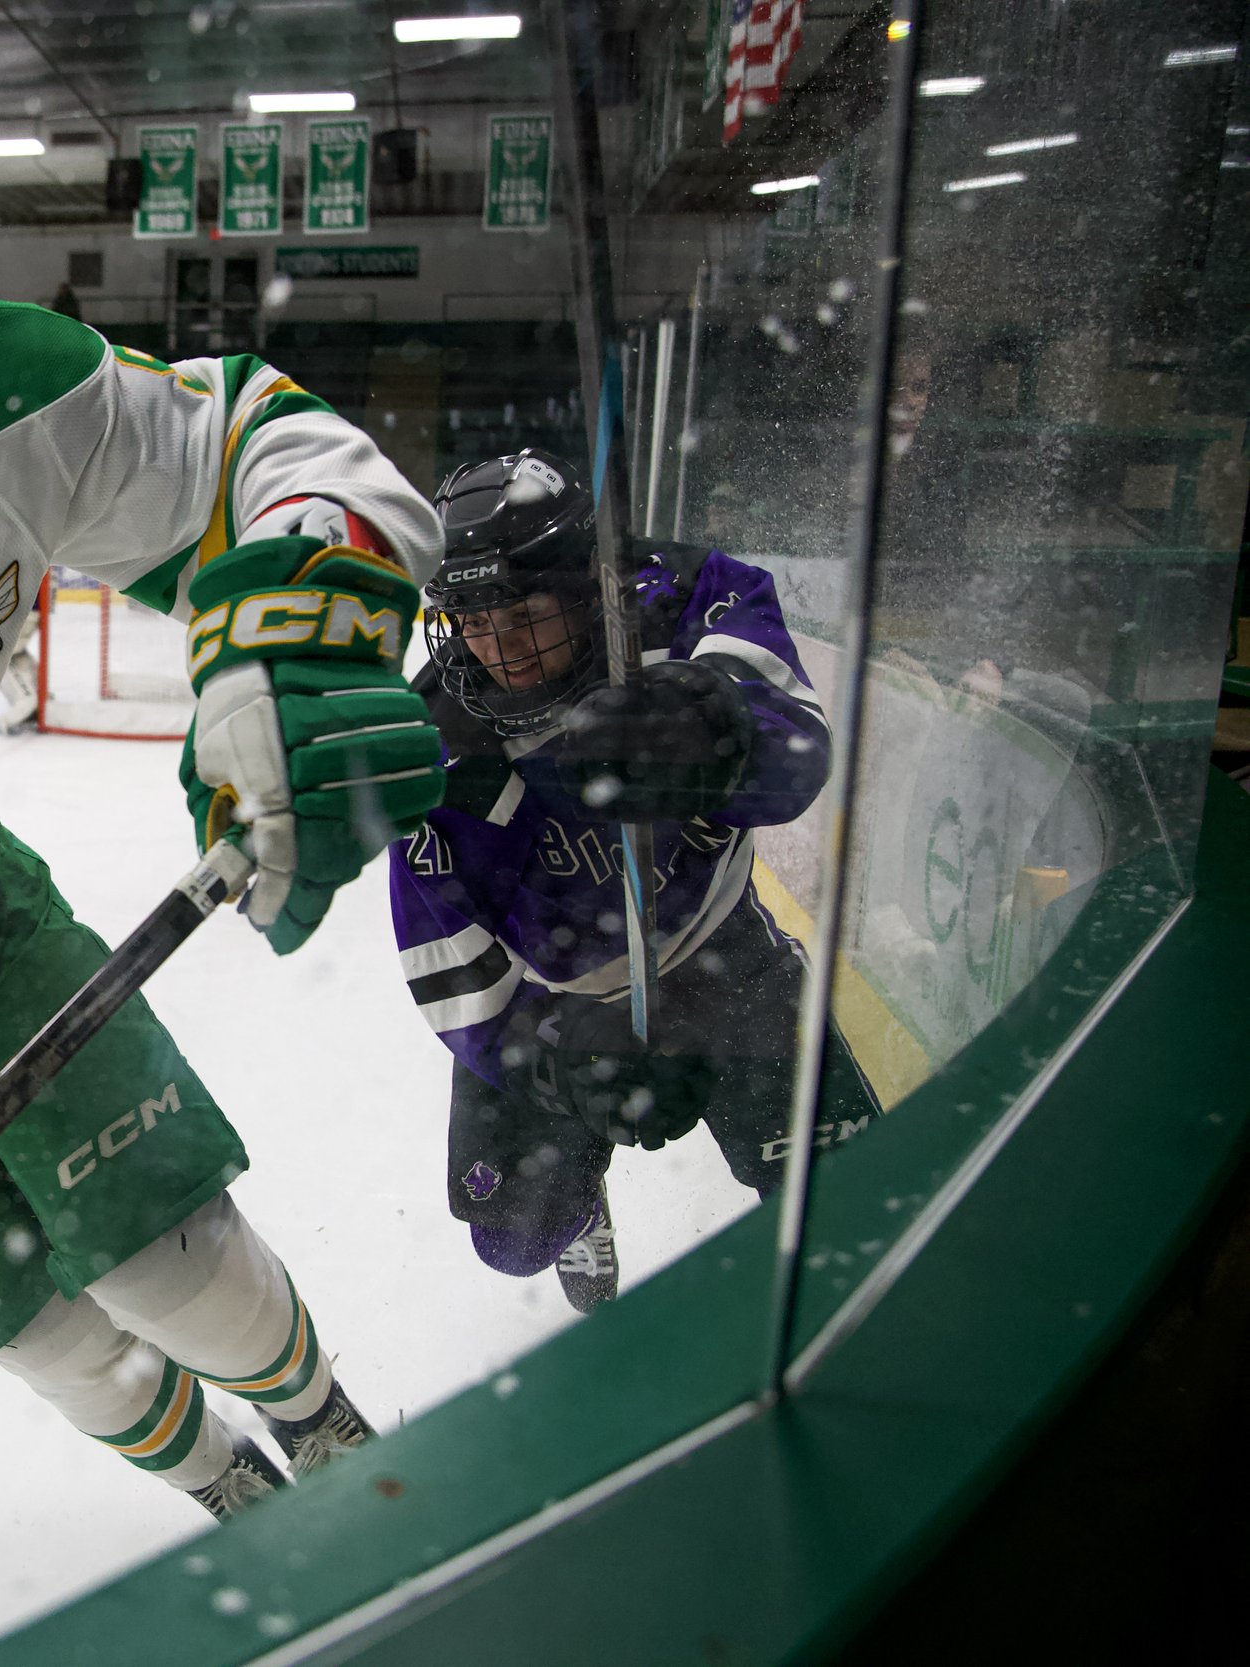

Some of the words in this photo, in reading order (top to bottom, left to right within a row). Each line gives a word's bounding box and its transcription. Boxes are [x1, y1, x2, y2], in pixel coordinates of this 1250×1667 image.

[493, 121, 549, 139] EDINA
[582, 511, 598, 531] CC
[447, 563, 498, 583] CCM
[187, 590, 401, 682] CCM
[403, 821, 453, 876] 21
[536, 814, 740, 893] BIN
[56, 1082, 183, 1191] CCM
